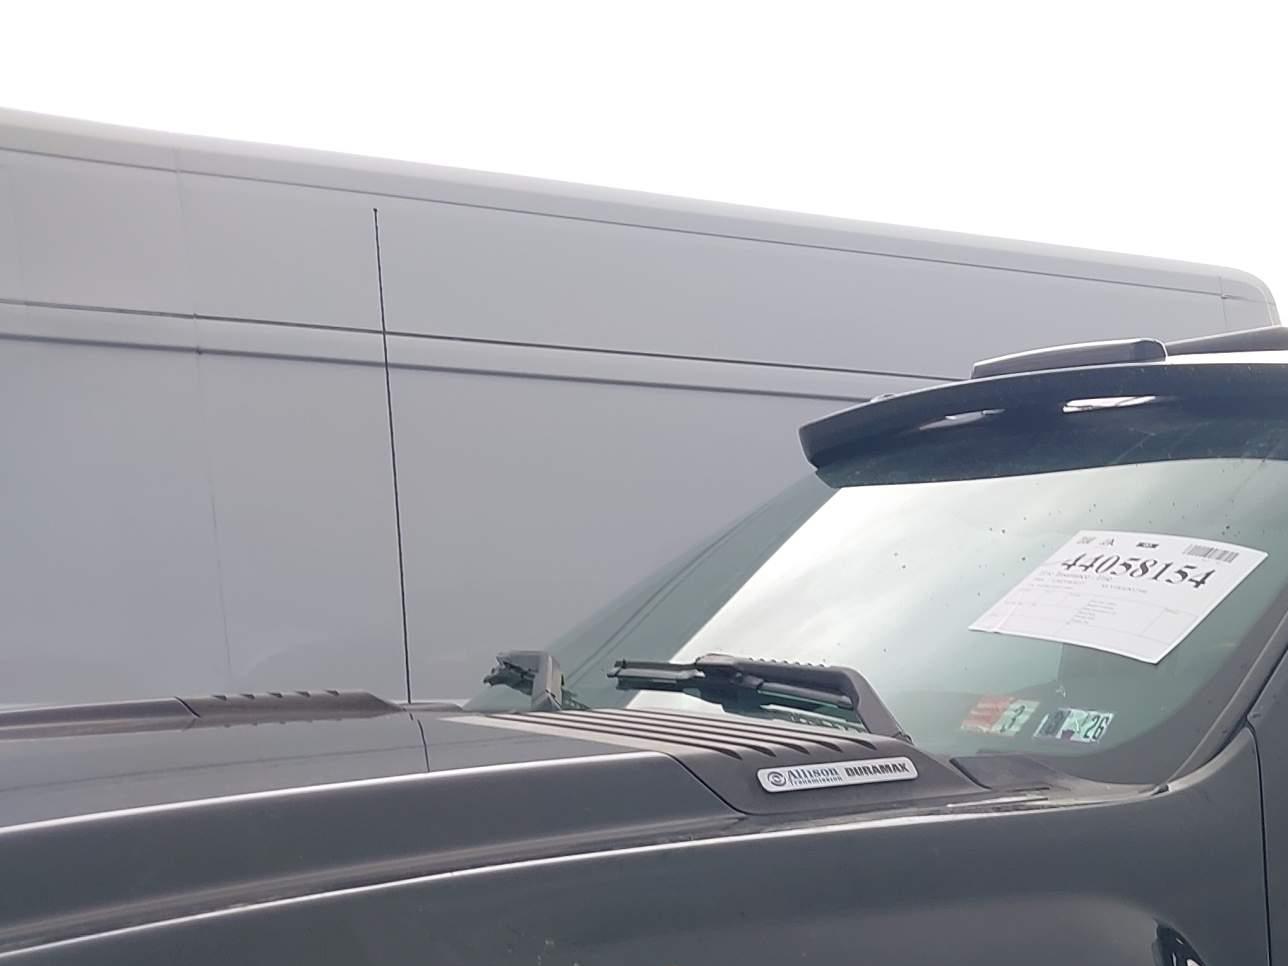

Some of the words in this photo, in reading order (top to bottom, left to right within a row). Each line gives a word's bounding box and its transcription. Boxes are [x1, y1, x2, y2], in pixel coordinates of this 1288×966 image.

[1062, 552, 1216, 589] 44058154
[788, 767, 839, 779] Allison
[844, 763, 909, 777] DURAMAX
